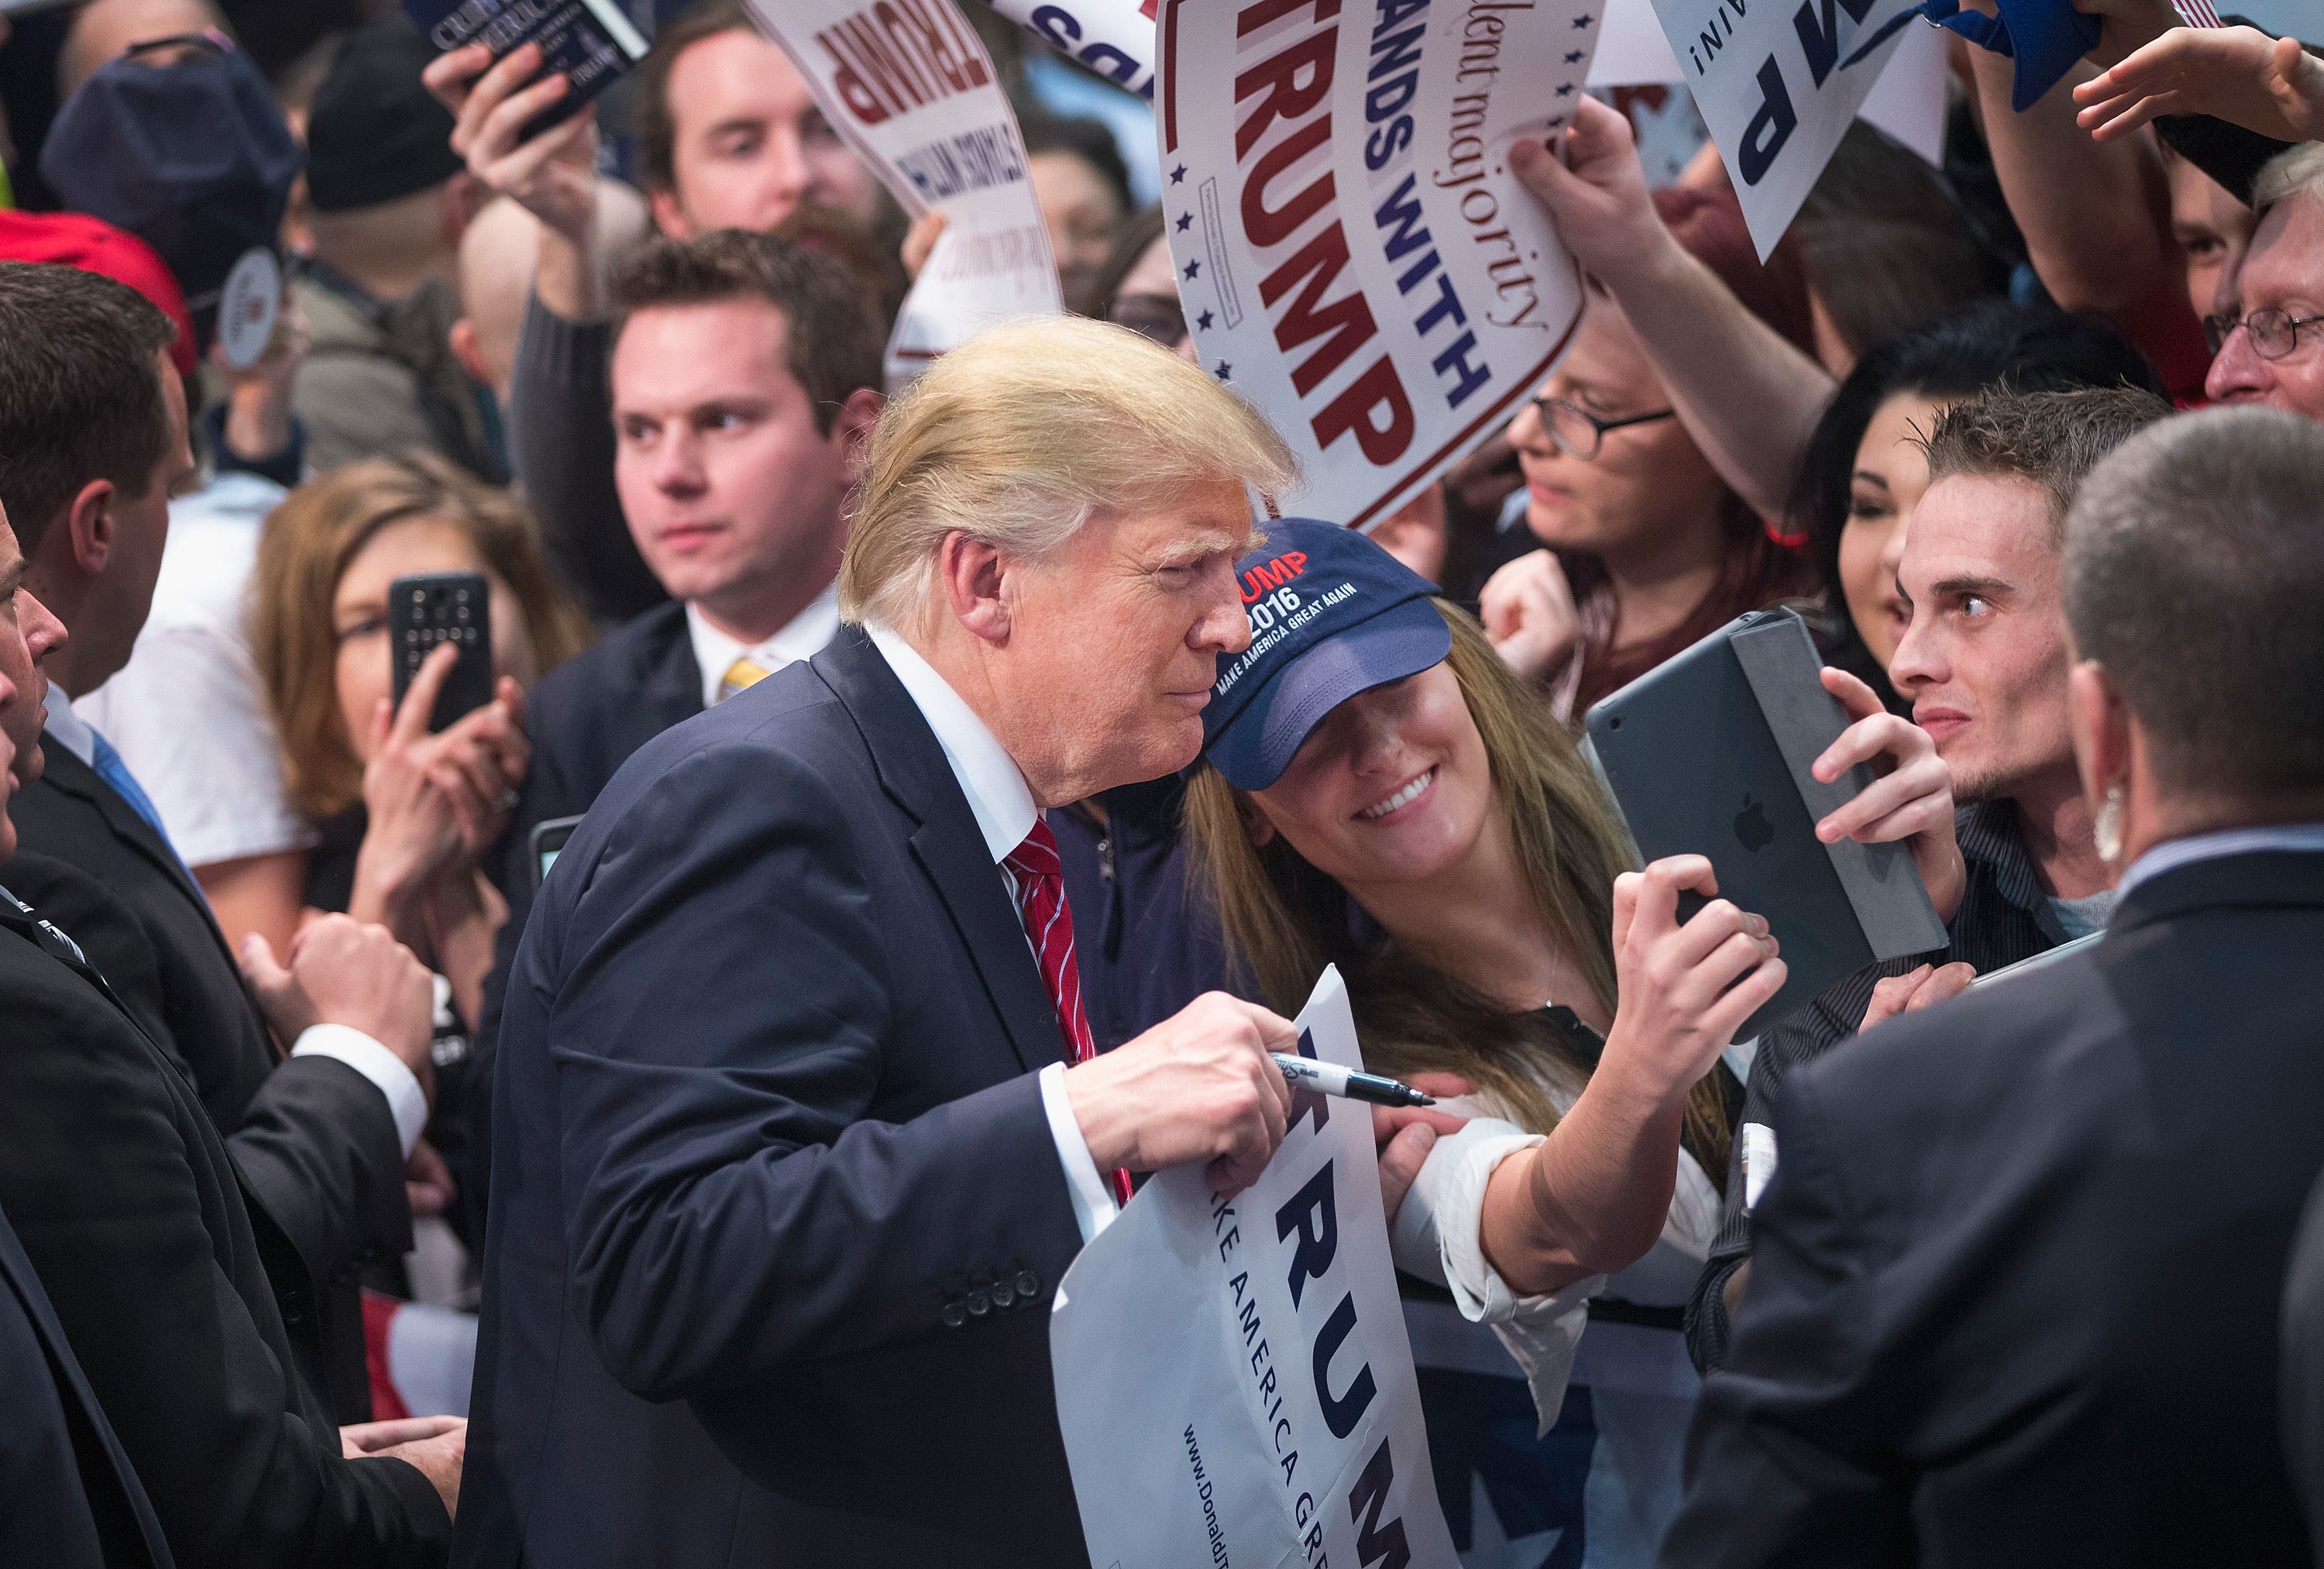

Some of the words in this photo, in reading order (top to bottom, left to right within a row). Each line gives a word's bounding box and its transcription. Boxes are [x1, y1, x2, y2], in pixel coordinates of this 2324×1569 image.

[1374, 170, 1494, 411] WITH
[1432, 92, 1549, 329] majority
[1216, 662, 1243, 696] MAKE
[1241, 625, 1289, 669] AMERICA
[1288, 600, 1323, 630] GREAT
[1322, 583, 1357, 607] AGAIN
[1210, 1192, 1239, 1264] KE
[1229, 1271, 1298, 1488] AMERICA
